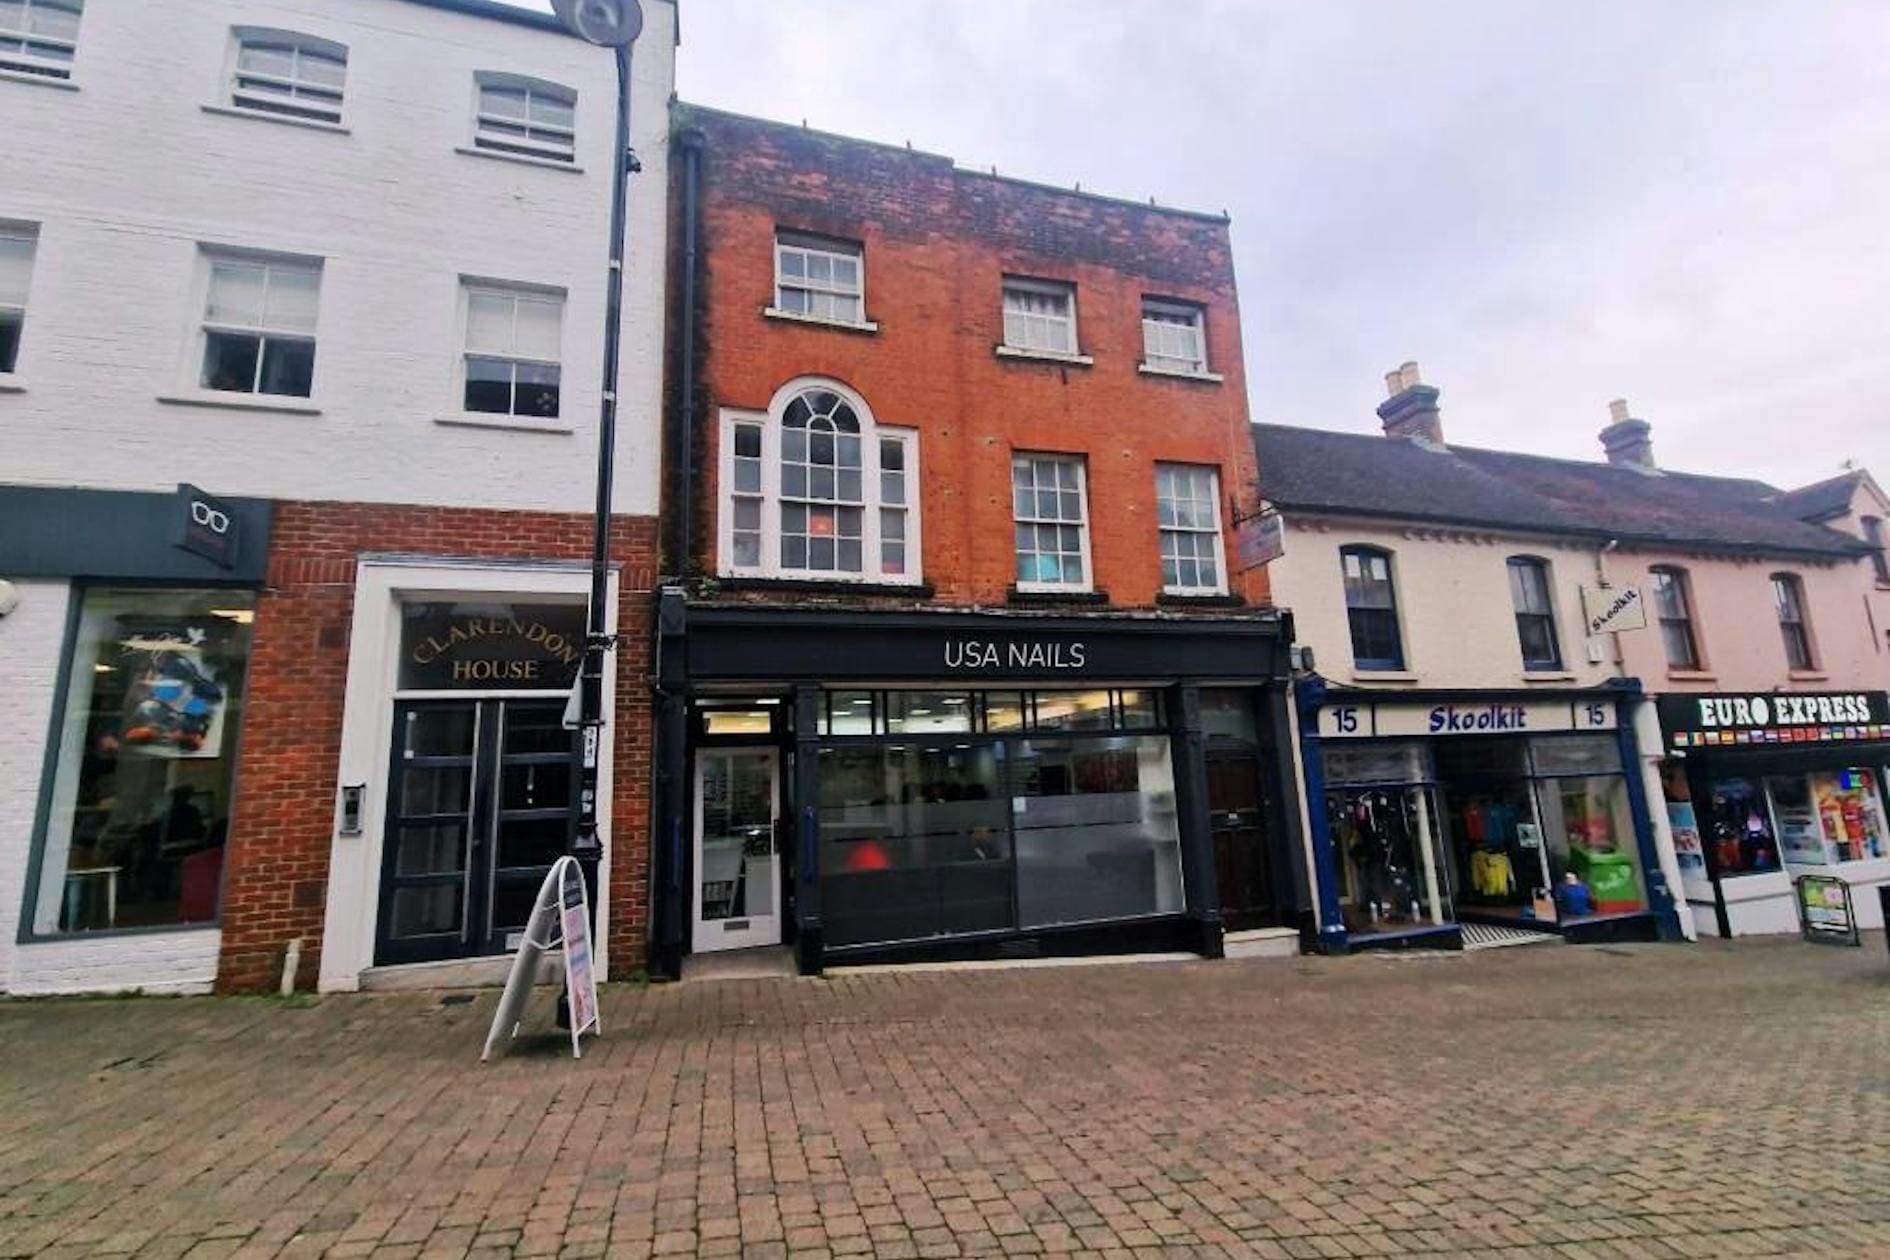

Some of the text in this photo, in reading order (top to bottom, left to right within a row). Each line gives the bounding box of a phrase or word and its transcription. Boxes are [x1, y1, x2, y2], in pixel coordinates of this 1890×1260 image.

[1592, 590, 1637, 631] Skoolkit
[413, 616, 578, 665] CLARENDON
[945, 641, 1085, 667] USA NAILS
[453, 660, 539, 680] HOUSE
[1332, 707, 1357, 733] 15
[1429, 706, 1526, 732] Skoolkit
[1584, 704, 1605, 726] 15
[1698, 695, 1871, 727] EURO EXPRESS
